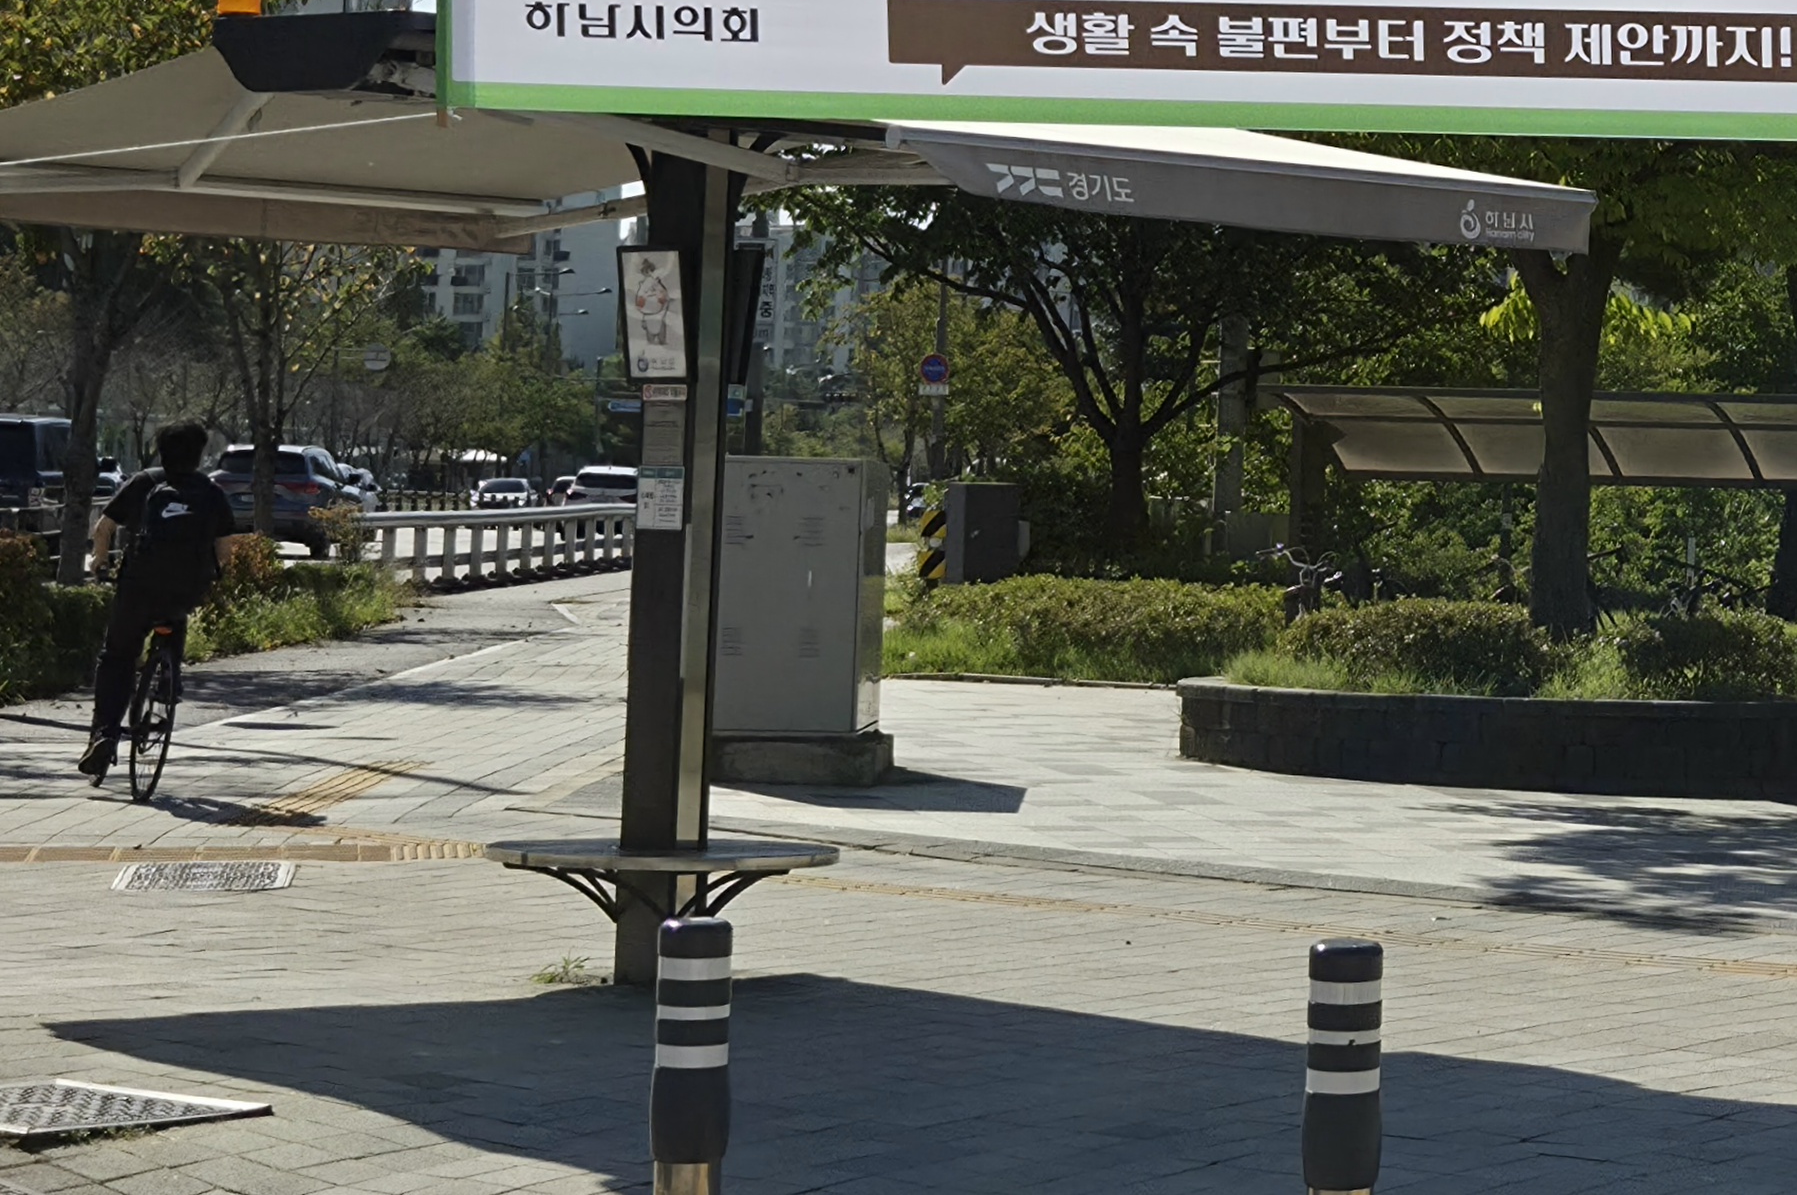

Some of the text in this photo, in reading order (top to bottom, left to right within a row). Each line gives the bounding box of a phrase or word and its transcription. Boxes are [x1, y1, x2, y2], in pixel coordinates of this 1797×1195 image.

[525, 1, 759, 43] 하남시의회
[1026, 11, 1792, 69] 생활 속 불편부터 정책 제안까지!
[1066, 171, 1135, 202] 경기도
